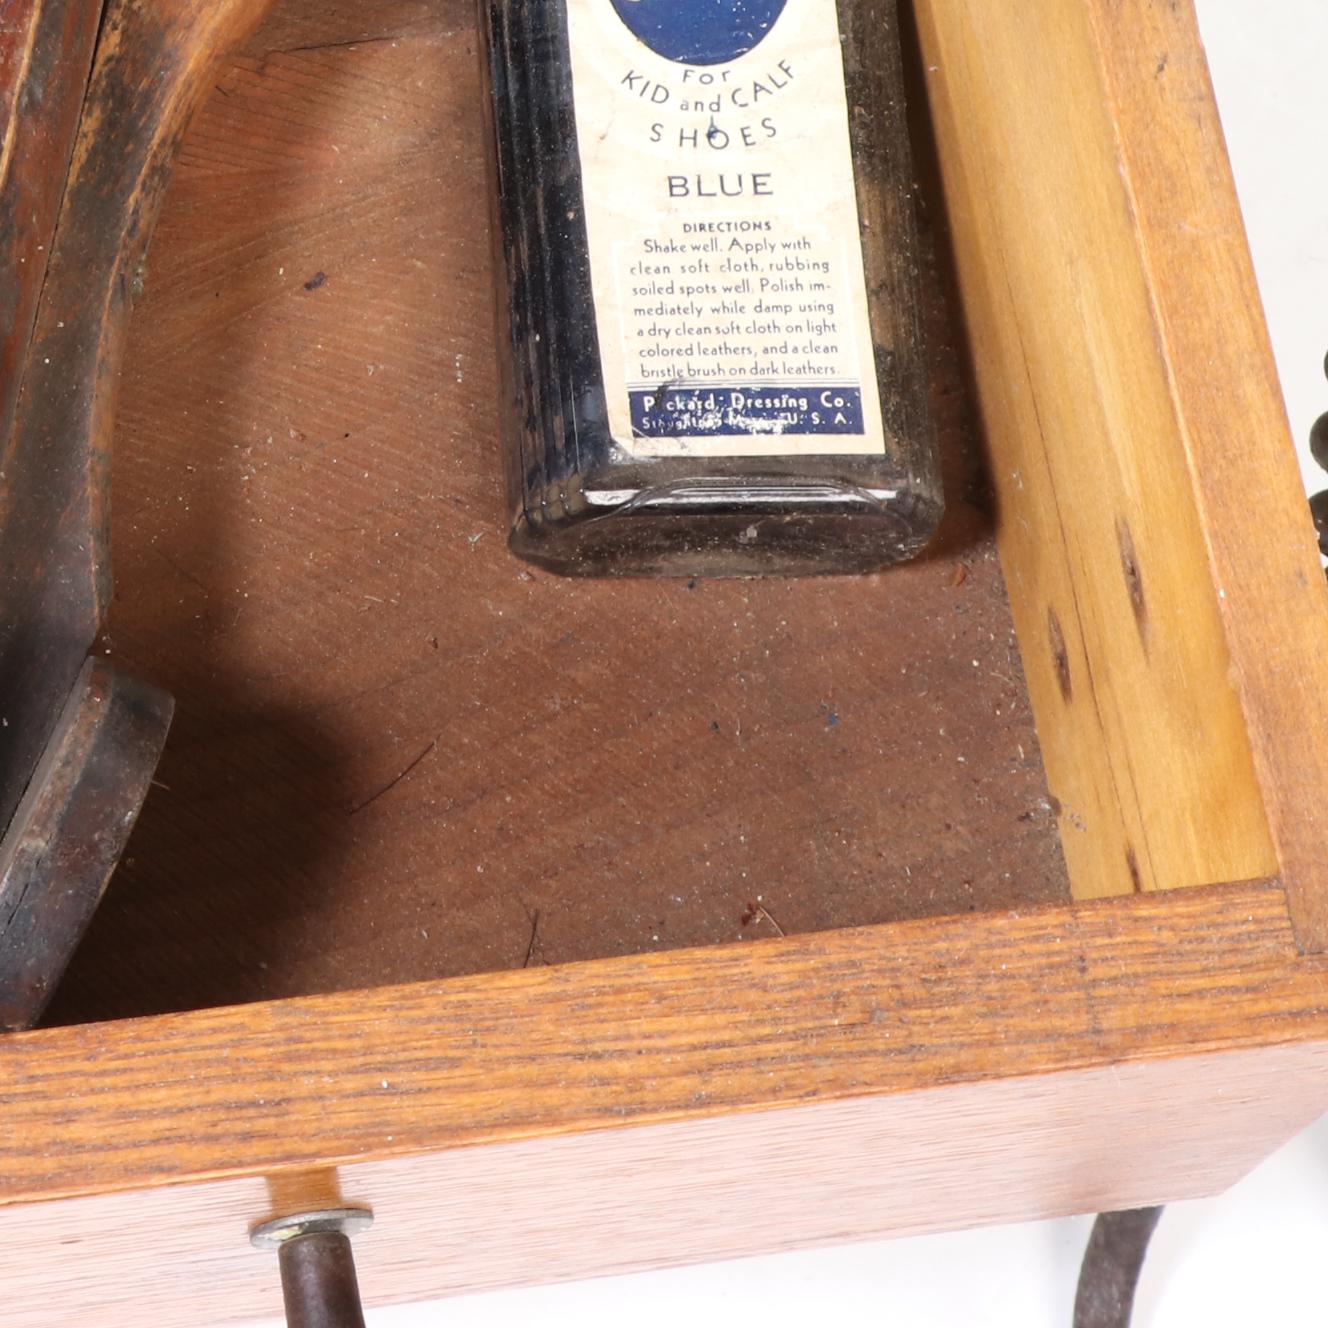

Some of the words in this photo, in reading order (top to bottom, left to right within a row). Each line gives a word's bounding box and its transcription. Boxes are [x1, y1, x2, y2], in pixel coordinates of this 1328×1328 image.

[621, 70, 670, 104] KID
[680, 94, 721, 112] and
[731, 60, 794, 107] CALF
[650, 118, 776, 150] SHOES
[667, 173, 773, 197] BLUE
[683, 221, 772, 233] DIRECTIONS
[644, 238, 687, 253] Shake
[690, 237, 723, 252] well.
[728, 237, 776, 254] Apply
[781, 236, 811, 250] with
[630, 260, 671, 275] clean
[680, 258, 710, 274] soft
[719, 257, 765, 273] cloth,
[769, 256, 830, 273] rubbing
[632, 280, 675, 296] soiled
[679, 284, 717, 297] spots
[759, 277, 804, 292] Polish
[809, 281, 832, 291] im-
[633, 300, 703, 318] mediately
[710, 300, 746, 315] while
[753, 298, 793, 315] damp
[799, 300, 834, 315] using
[637, 328, 644, 337] a
[647, 322, 671, 339] dry
[674, 321, 712, 335] clean
[715, 320, 742, 334] soft
[745, 319, 781, 334] cloth
[785, 324, 803, 333] on
[806, 317, 837, 336] light
[639, 342, 694, 358] colored
[697, 341, 758, 358] leathers,
[762, 340, 789, 355] and
[791, 345, 799, 354] a
[802, 339, 839, 353] clean
[640, 363, 684, 378] bristle
[687, 361, 726, 377] brush
[728, 366, 747, 376] on
[749, 360, 780, 376] dark
[782, 359, 841, 375] leathers.
[643, 393, 716, 412] Pckard
[730, 392, 809, 411] Dressing
[820, 390, 852, 408] Co.
[811, 411, 826, 425] S.
[833, 412, 853, 425] A.
